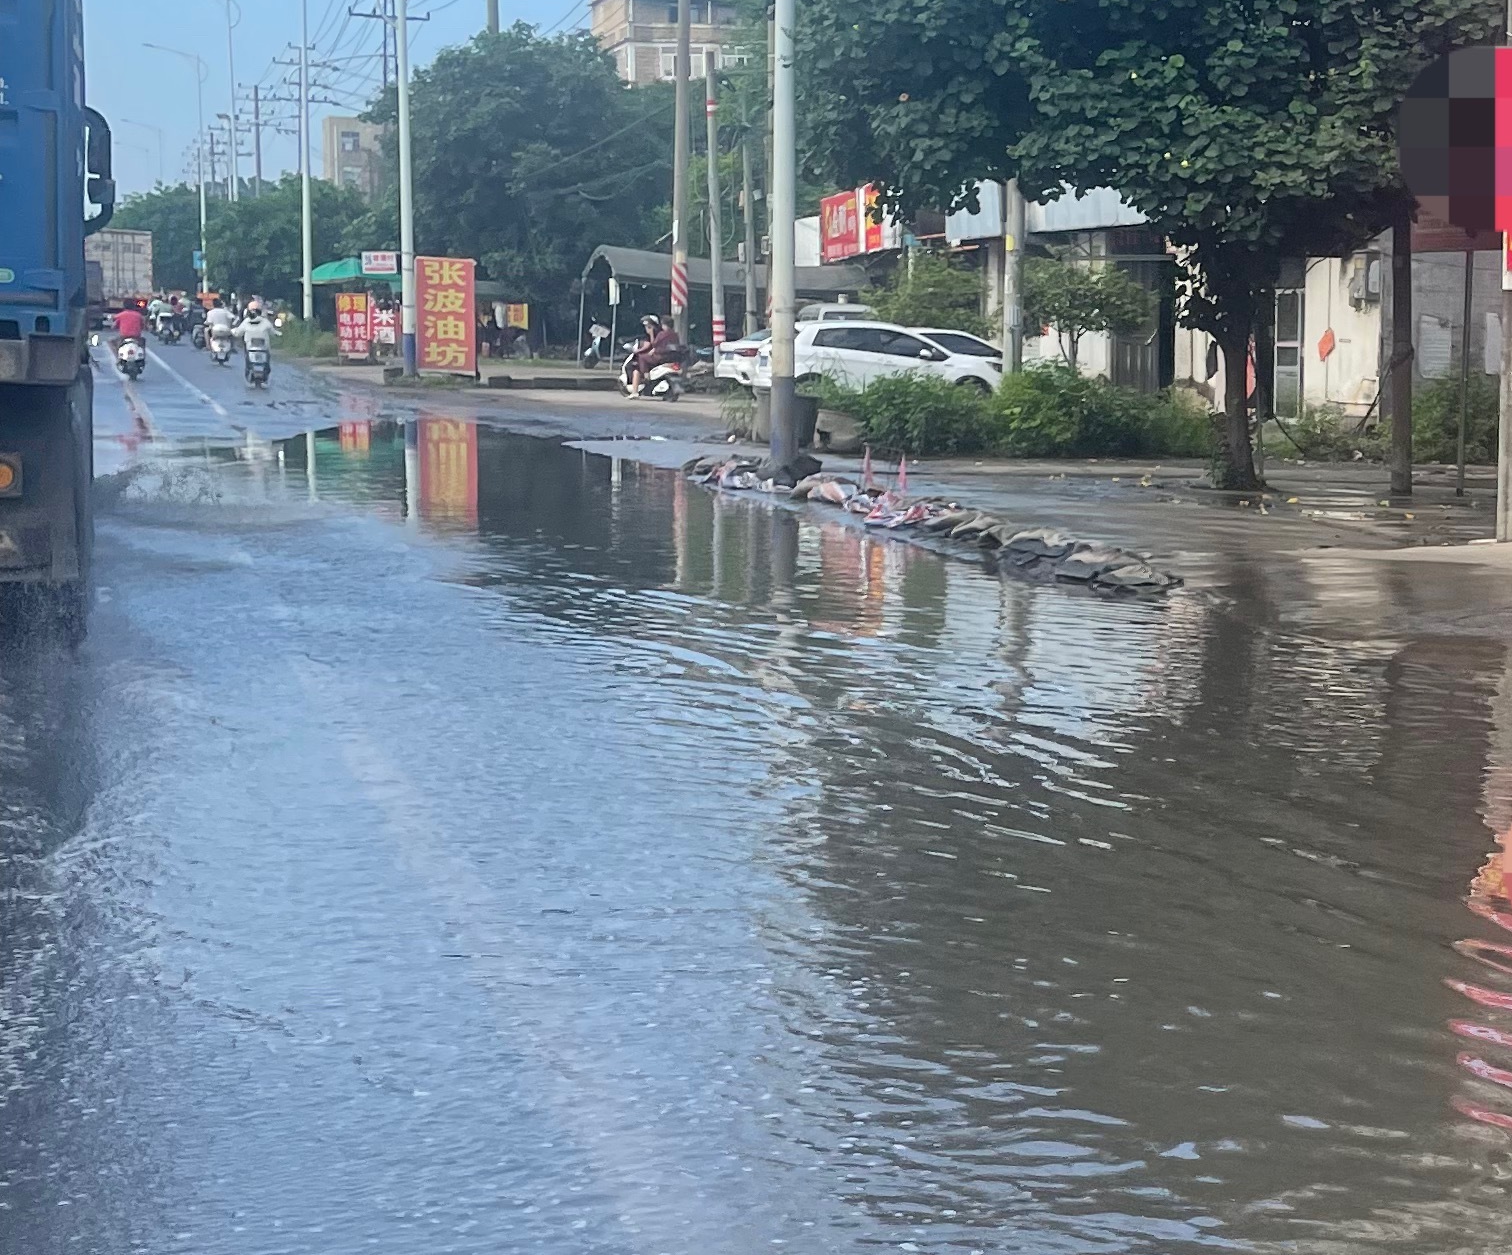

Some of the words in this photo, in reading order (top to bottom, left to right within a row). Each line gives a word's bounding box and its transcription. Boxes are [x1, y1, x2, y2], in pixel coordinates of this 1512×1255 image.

[372, 308, 396, 344] 米酒
[423, 260, 468, 367] 张波油坊
